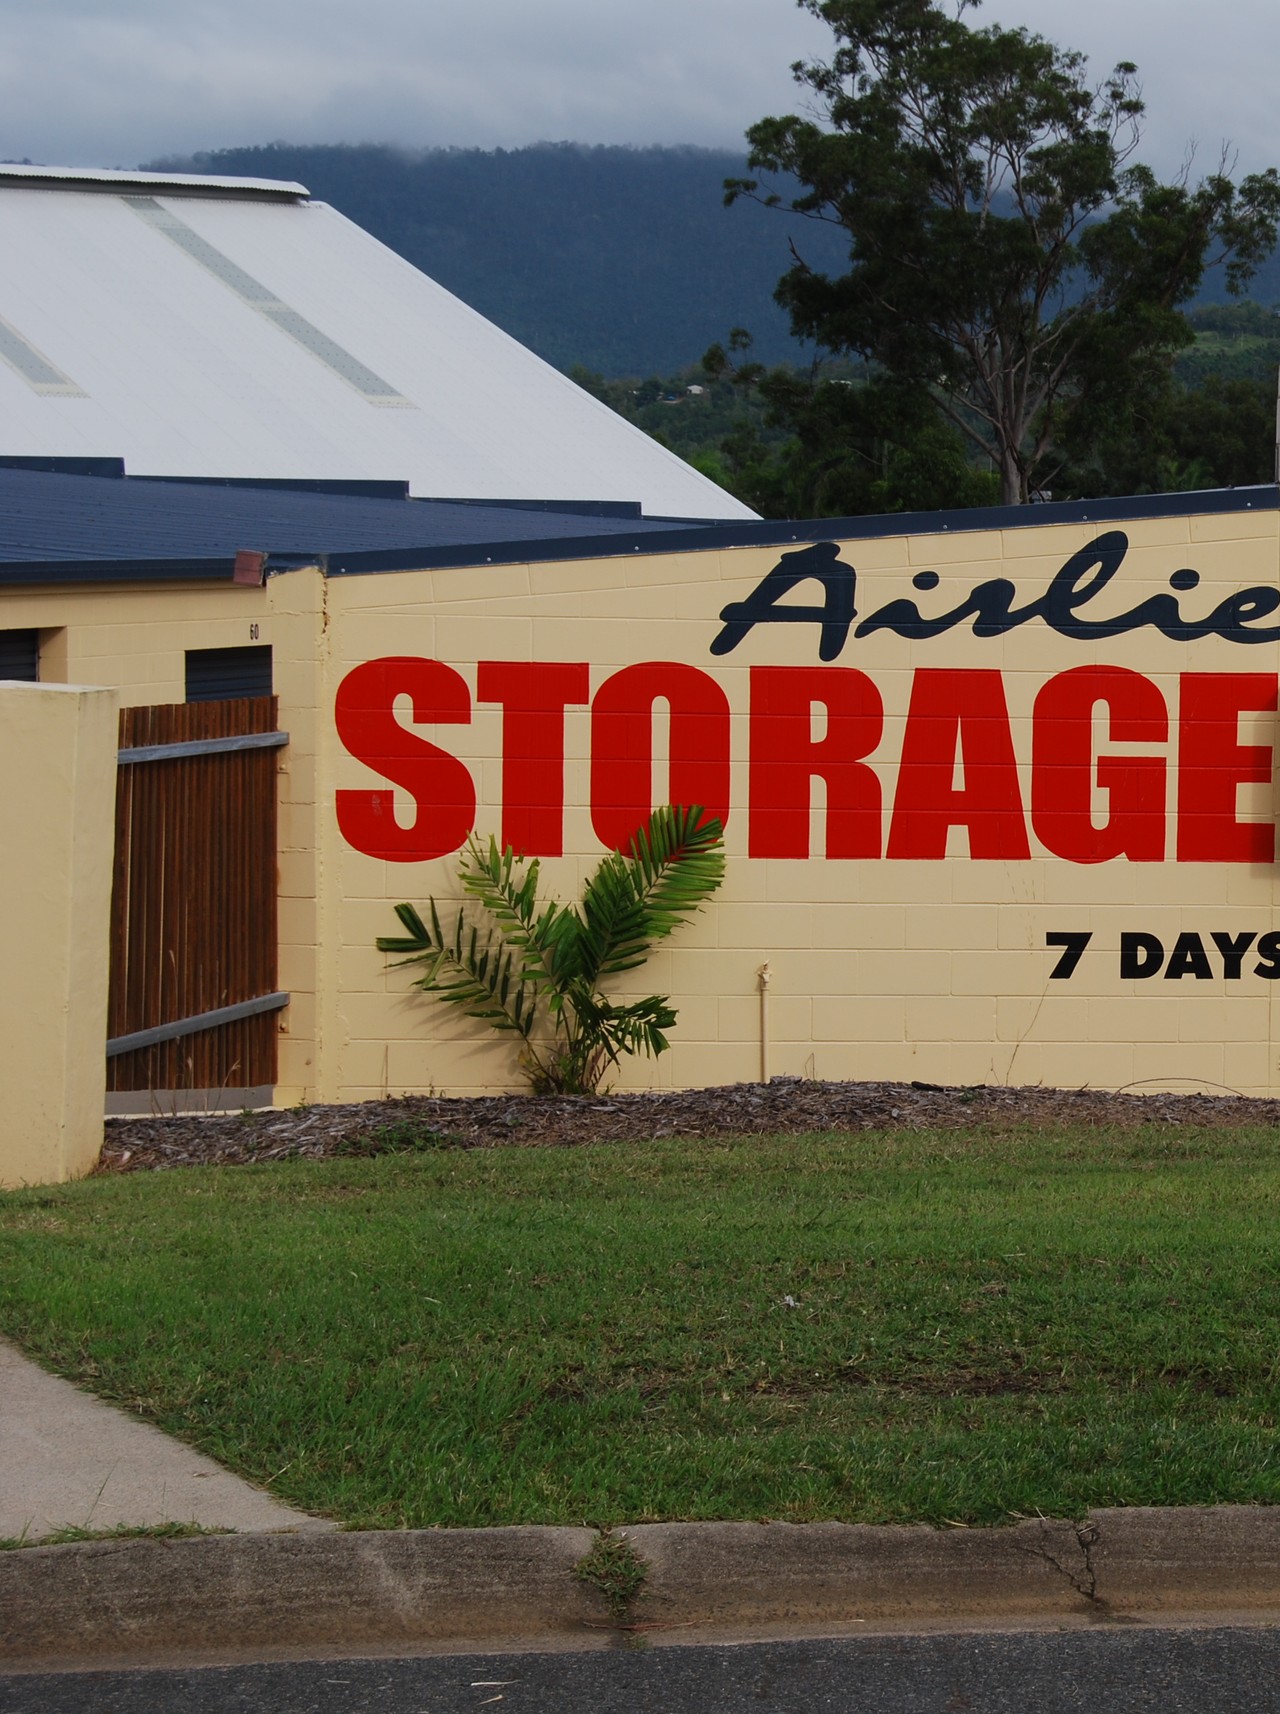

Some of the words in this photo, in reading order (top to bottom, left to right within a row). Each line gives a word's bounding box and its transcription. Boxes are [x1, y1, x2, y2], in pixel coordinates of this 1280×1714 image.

[250, 623, 259, 640] 60
[336, 656, 1279, 864] STORAGE
[1045, 931, 1094, 980] 7
